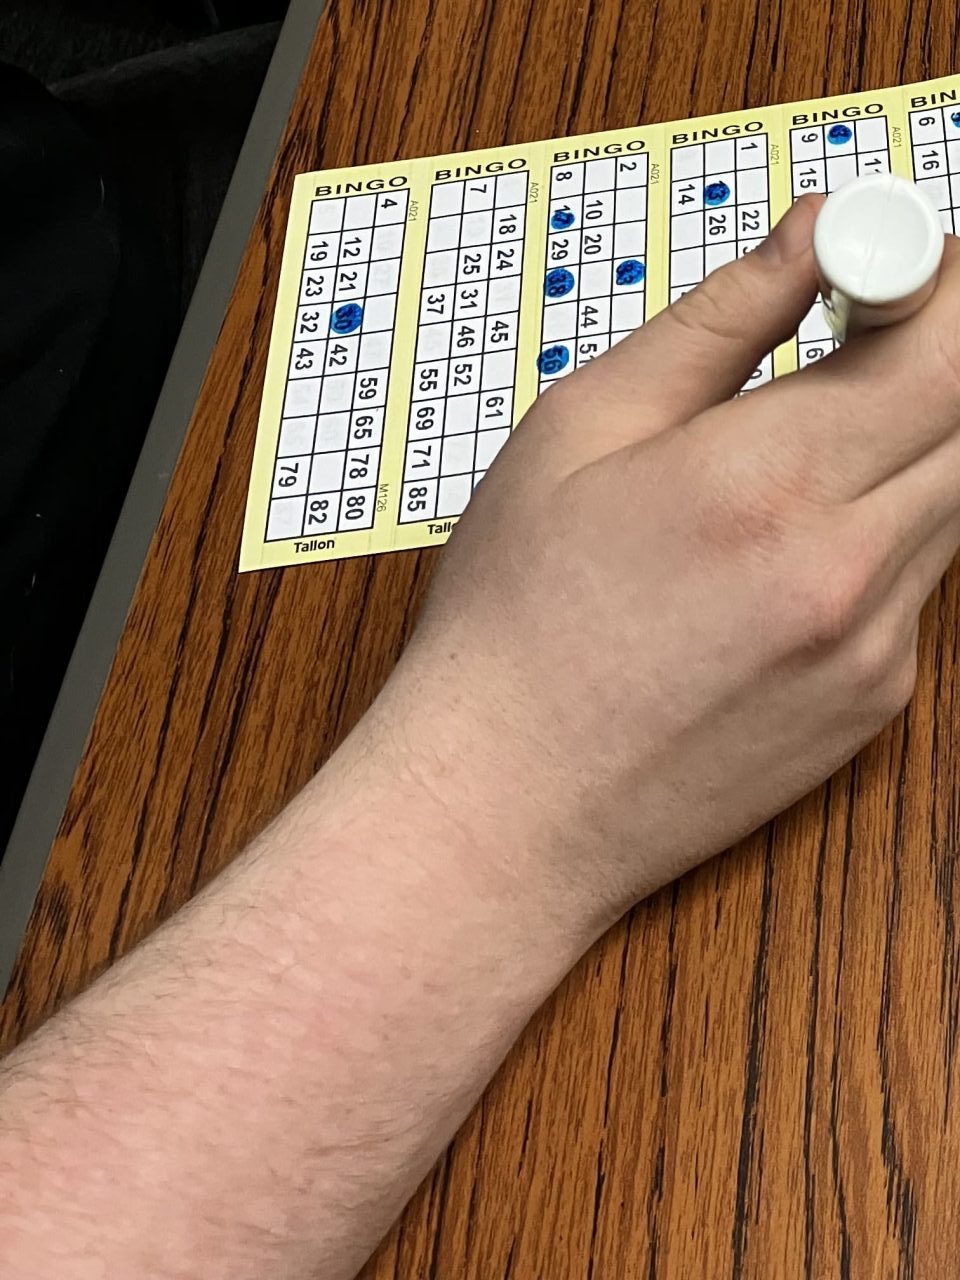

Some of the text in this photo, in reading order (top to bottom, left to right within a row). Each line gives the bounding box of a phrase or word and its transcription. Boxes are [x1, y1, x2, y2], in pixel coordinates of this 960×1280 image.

[792, 103, 884, 126] BINGO
[918, 117, 935, 126] 6
[671, 121, 763, 144] BINGO
[801, 133, 818, 143] 9
[892, 126, 903, 148] A021
[553, 140, 646, 163] BINGO
[741, 142, 758, 151] 1
[770, 144, 780, 166] A021
[435, 158, 527, 181] BINGO
[619, 162, 637, 172] 2
[922, 150, 939, 170] 16
[556, 171, 572, 181] 8
[650, 163, 660, 185] A021
[800, 167, 817, 188] 15
[315, 176, 408, 197] BINGO
[470, 184, 487, 194] 7
[529, 182, 539, 204] A021
[678, 183, 696, 205] 14
[706, 180, 726, 200] 13
[381, 198, 398, 209] 4
[409, 200, 419, 222] A021
[585, 199, 603, 220] 10
[498, 214, 517, 235] 18
[709, 215, 726, 236] 26
[742, 210, 760, 232] 22
[310, 241, 329, 261] 19
[343, 237, 362, 258] 12
[551, 238, 569, 260] 29
[584, 234, 602, 255] 20
[463, 253, 481, 275] 25
[495, 248, 514, 270] 24
[305, 275, 324, 297] 23
[339, 271, 357, 291] 21
[548, 273, 567, 297] 38
[427, 293, 445, 315] 37
[460, 289, 478, 310] 31
[300, 311, 319, 334] 32
[335, 306, 357, 330] 30
[581, 305, 598, 328] 44
[456, 325, 475, 348] 46
[490, 320, 509, 344] 45
[295, 347, 314, 370] 43
[329, 344, 348, 367] 42
[543, 346, 564, 374] 56
[419, 368, 438, 392] 55
[453, 363, 472, 387] 52
[358, 377, 378, 400] 59
[415, 406, 435, 431] 69
[484, 396, 504, 419] 61
[353, 415, 374, 440] 65
[349, 454, 369, 479] 78
[411, 445, 431, 469] 71
[278, 462, 299, 488] 79
[344, 495, 365, 520] 80
[376, 483, 389, 512] M126
[407, 486, 427, 512] 85
[308, 500, 329, 525] 82
[427, 522, 456, 535] Tall
[294, 539, 335, 553] Tallon
